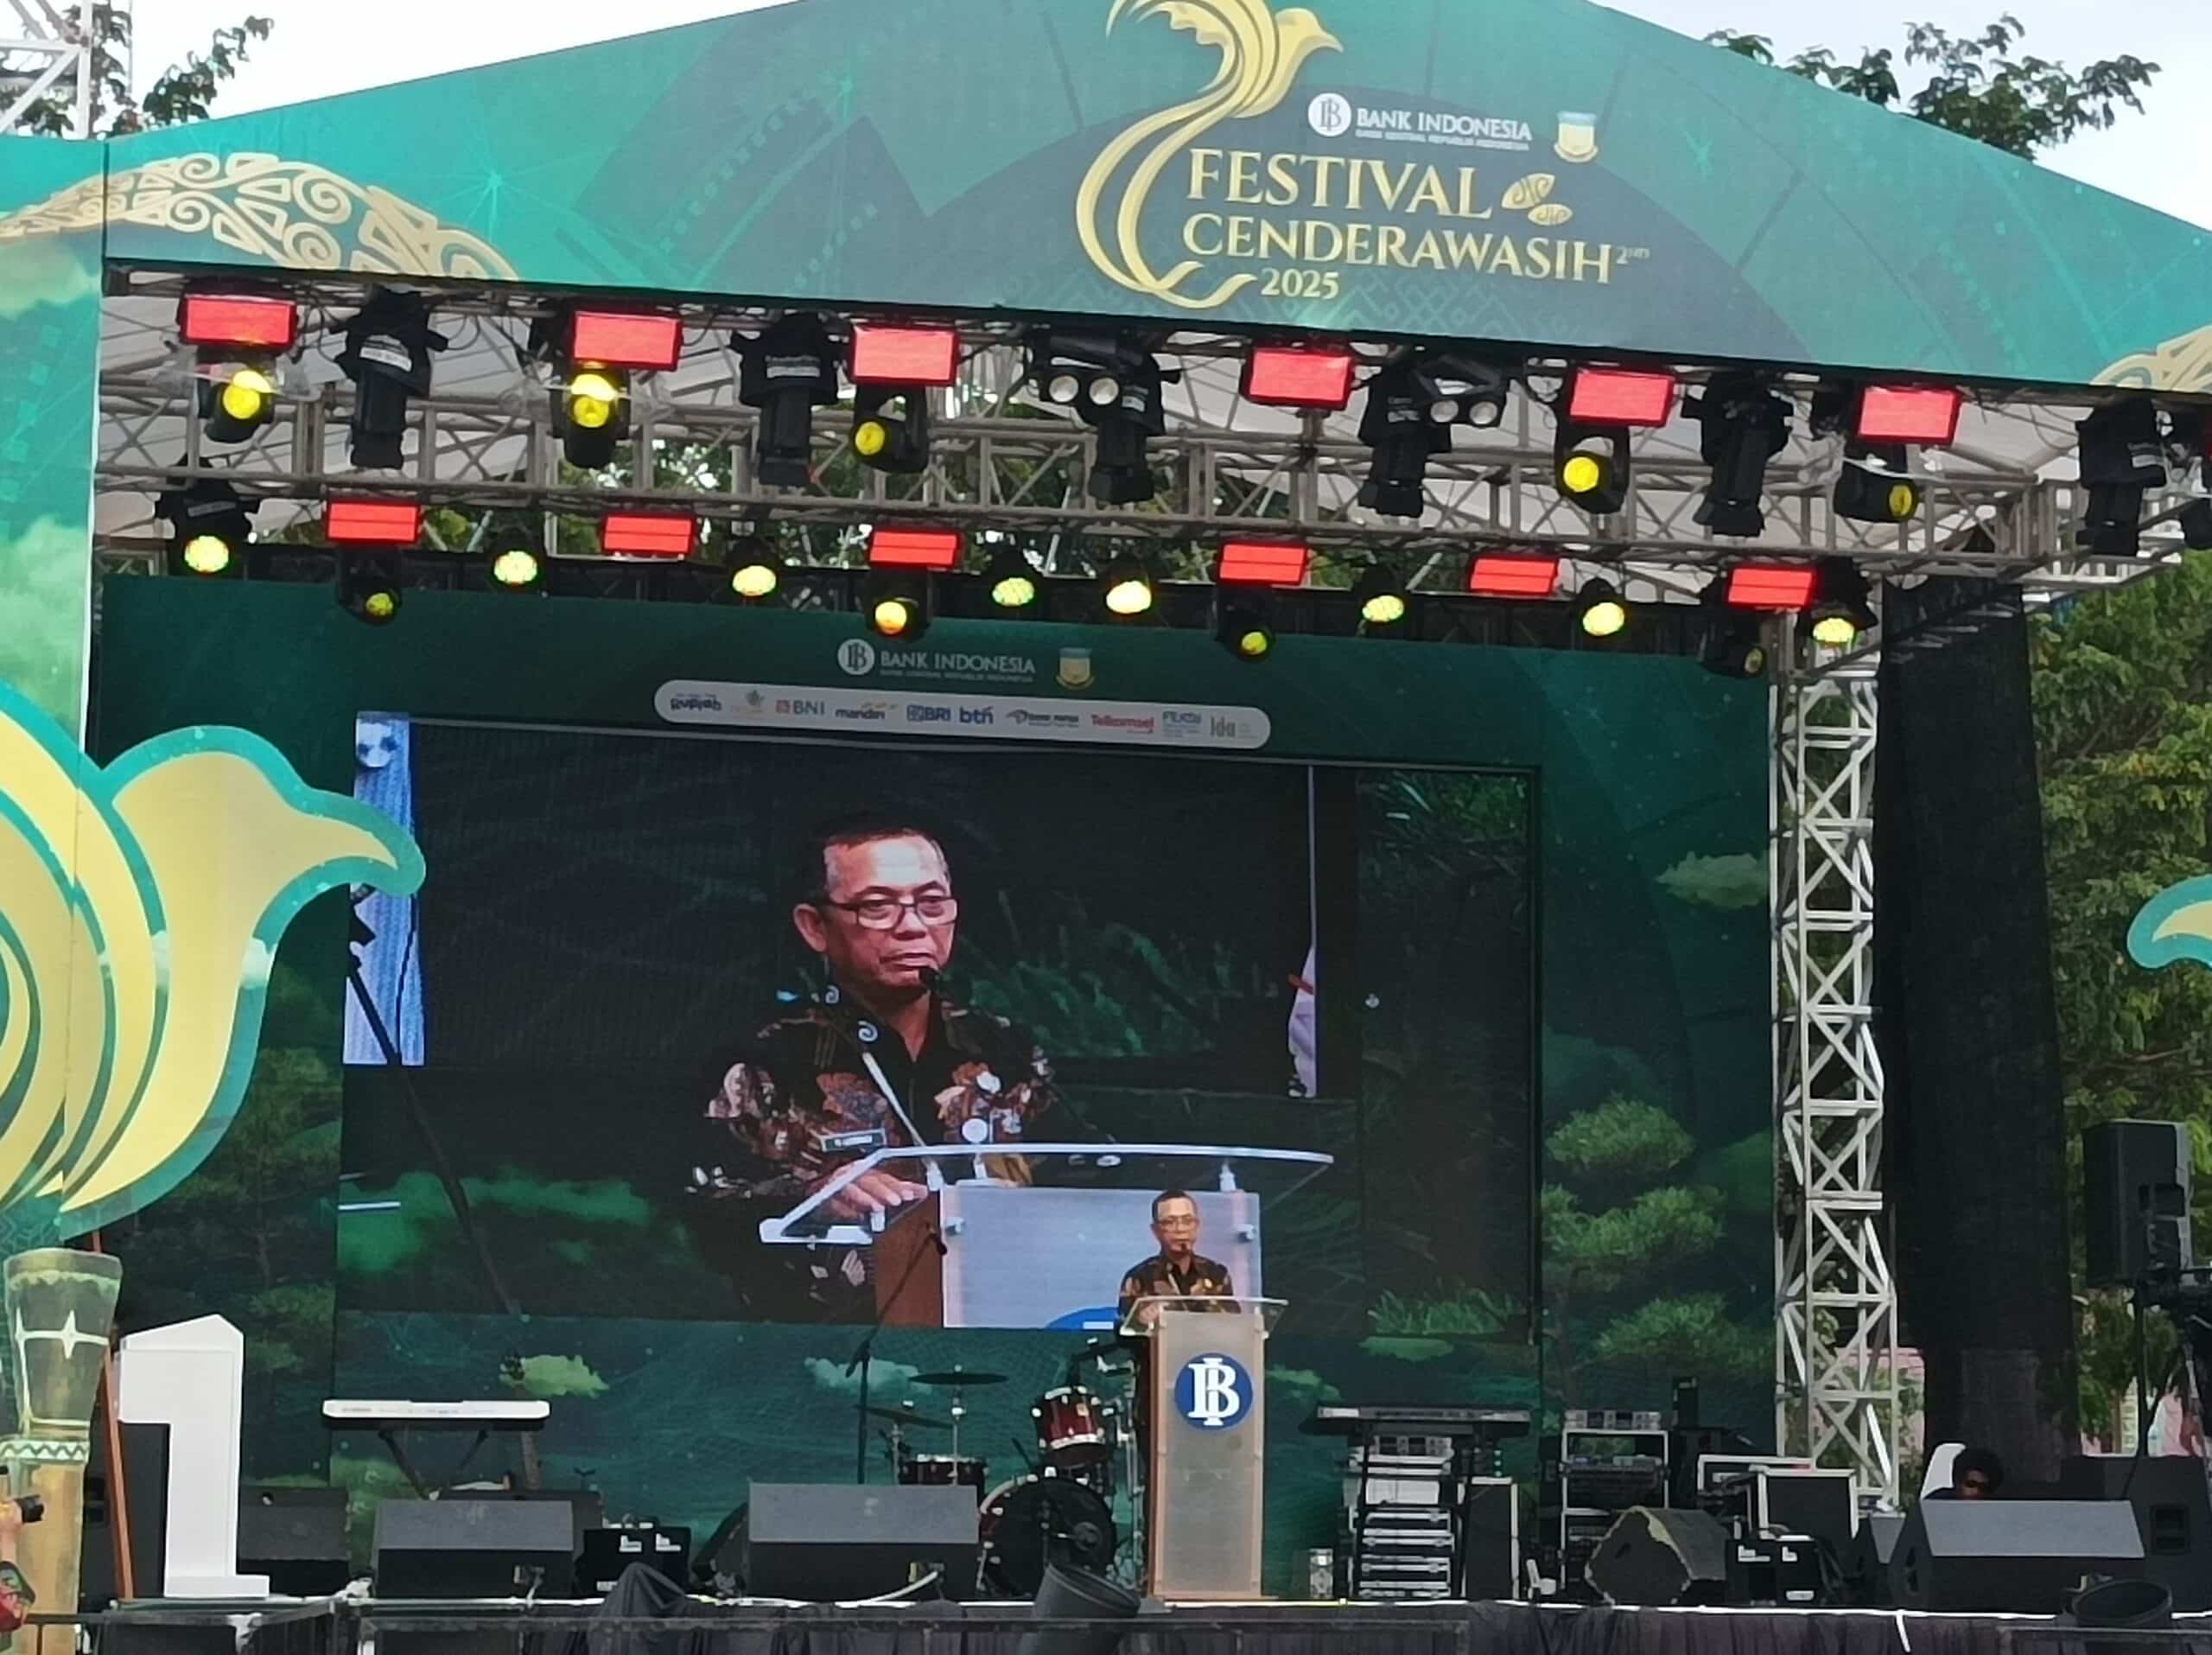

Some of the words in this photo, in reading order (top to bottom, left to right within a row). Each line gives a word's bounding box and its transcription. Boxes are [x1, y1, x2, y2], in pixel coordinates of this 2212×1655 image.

[1357, 108, 1411, 130] BANK
[1418, 112, 1533, 141] INDONESIA
[1187, 148, 1493, 220] FESTIVAL
[1181, 213, 1612, 283] CENDERAWASIH
[1260, 266, 1340, 299] 2025
[880, 651, 929, 669] BANK
[935, 652, 1037, 674] INDONESIA
[793, 699, 826, 716] BNI
[925, 706, 951, 722] BRI
